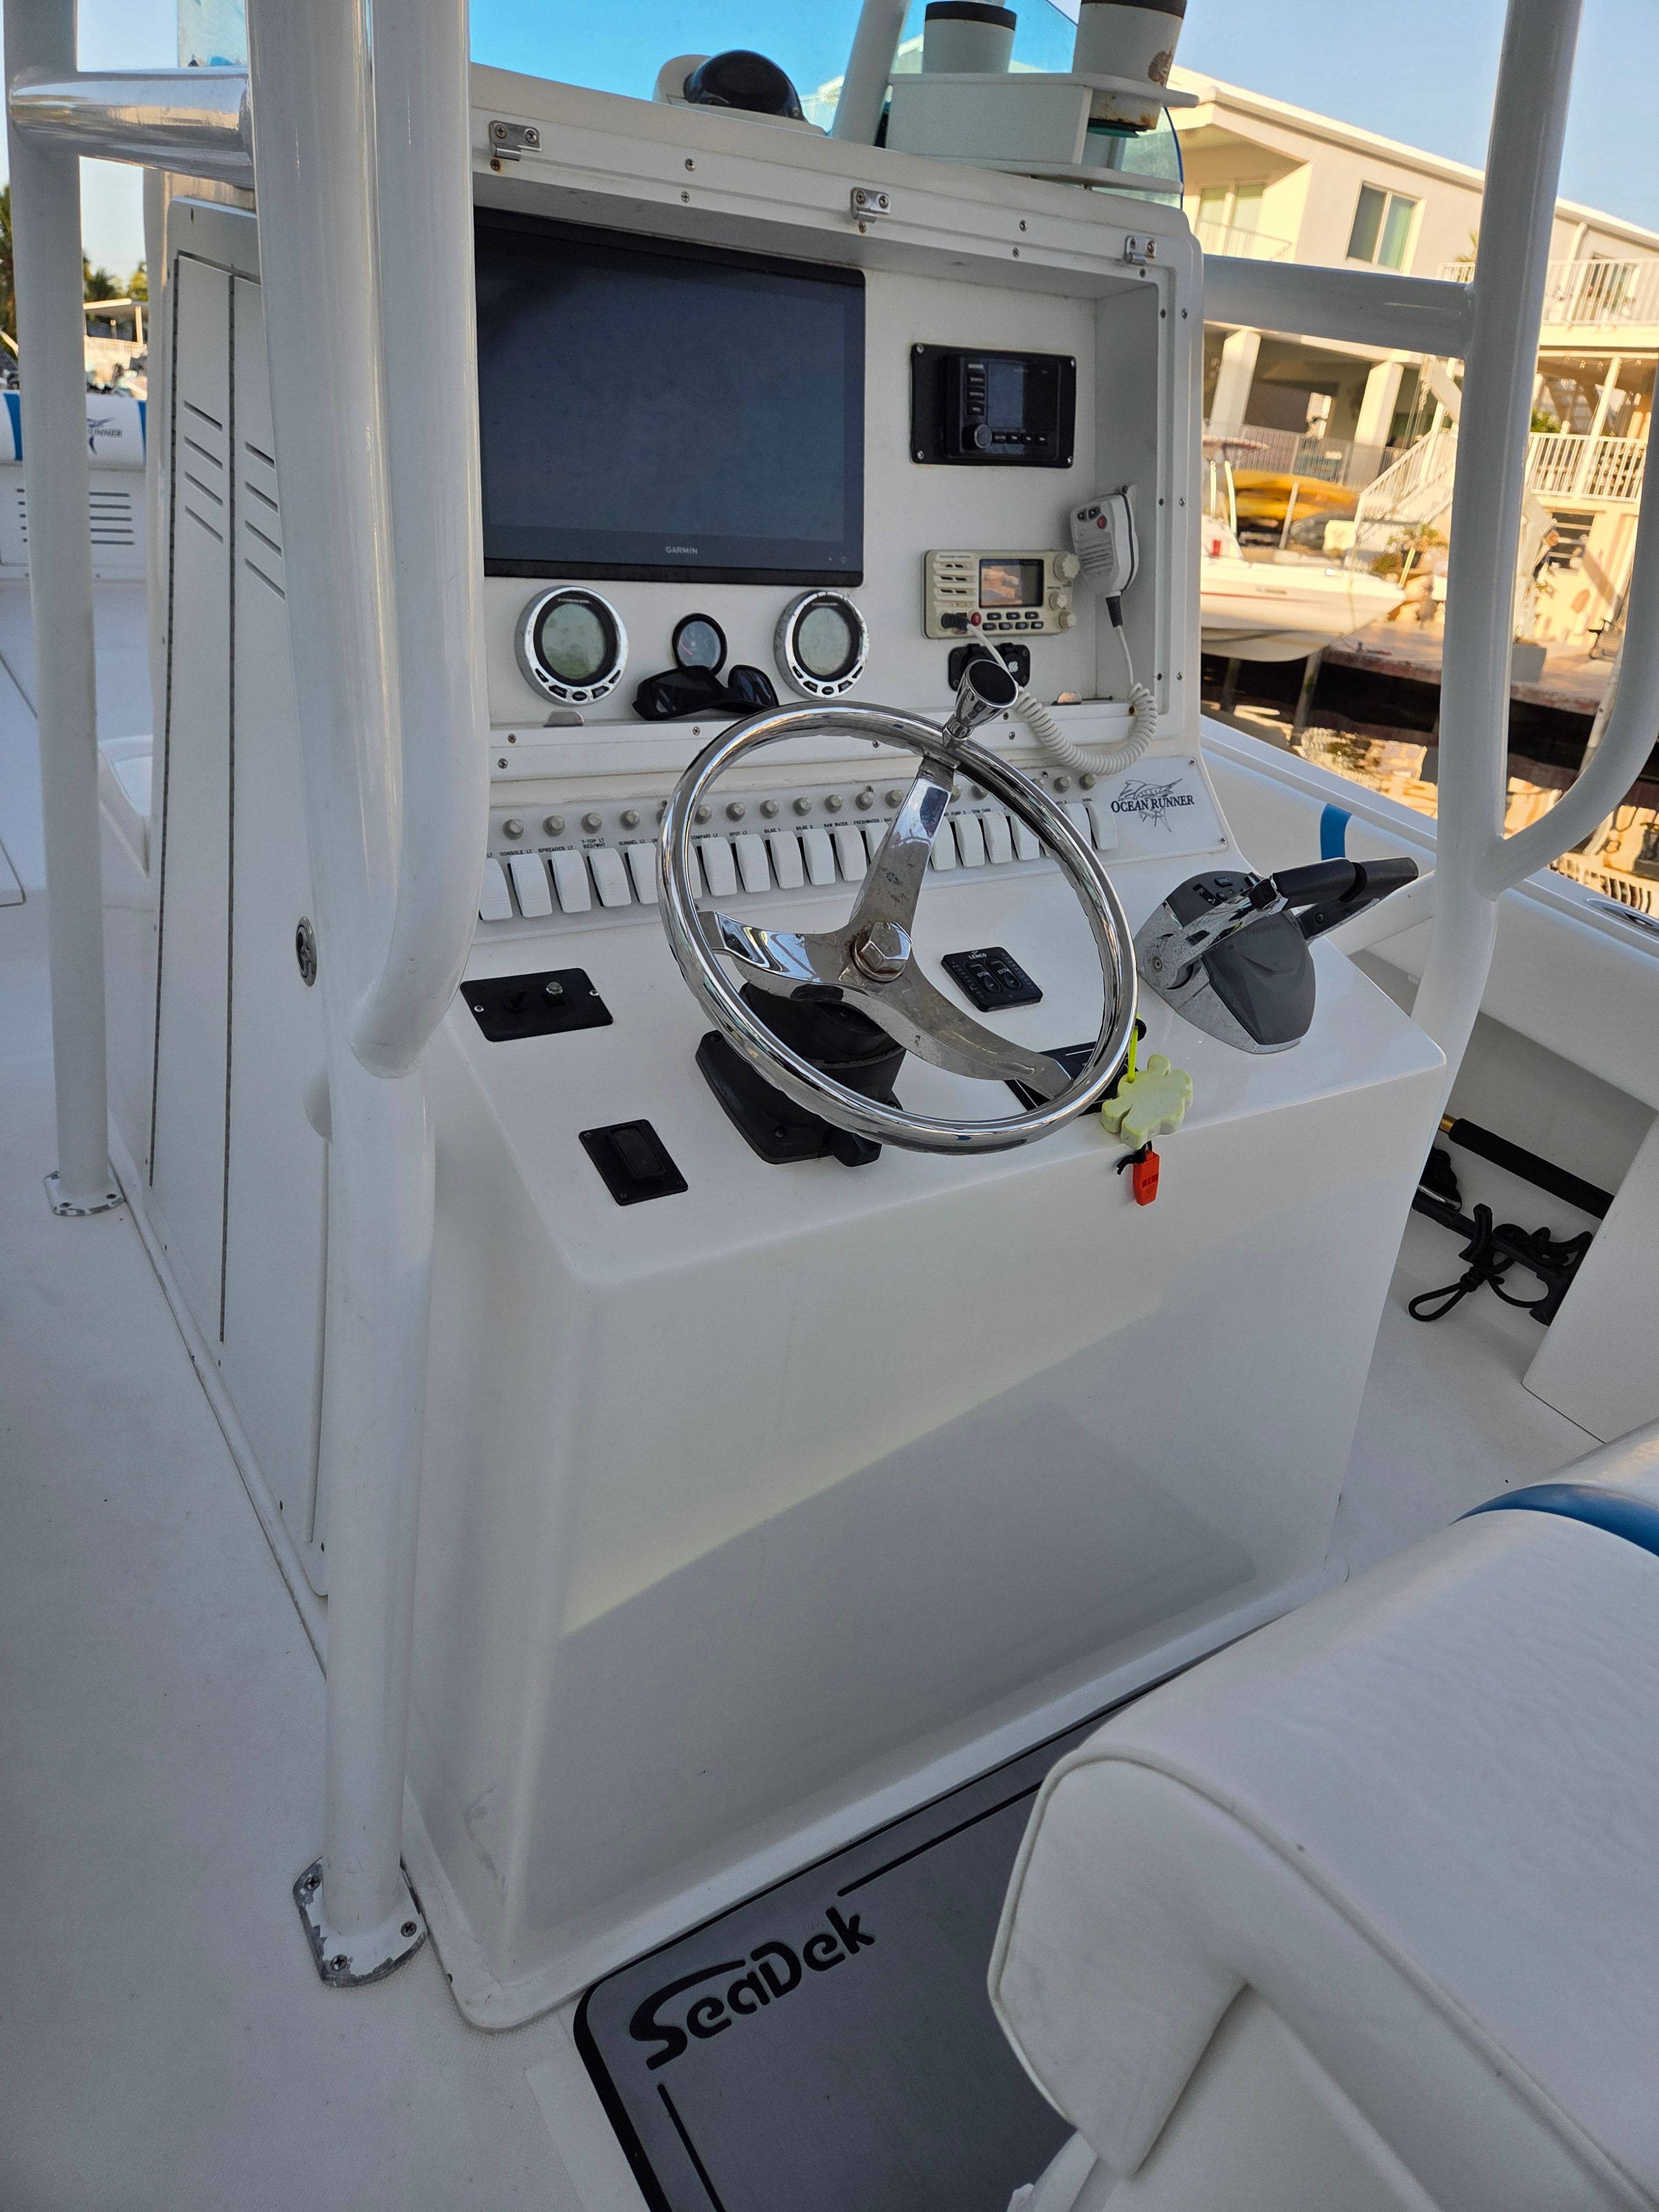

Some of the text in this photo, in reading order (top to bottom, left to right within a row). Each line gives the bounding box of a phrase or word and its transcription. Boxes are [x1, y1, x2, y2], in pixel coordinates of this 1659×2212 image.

[665, 546, 698, 555] GARMIN
[1110, 795, 1194, 813] OCEAN RUNNER
[629, 1906, 875, 2071] SeaDek
